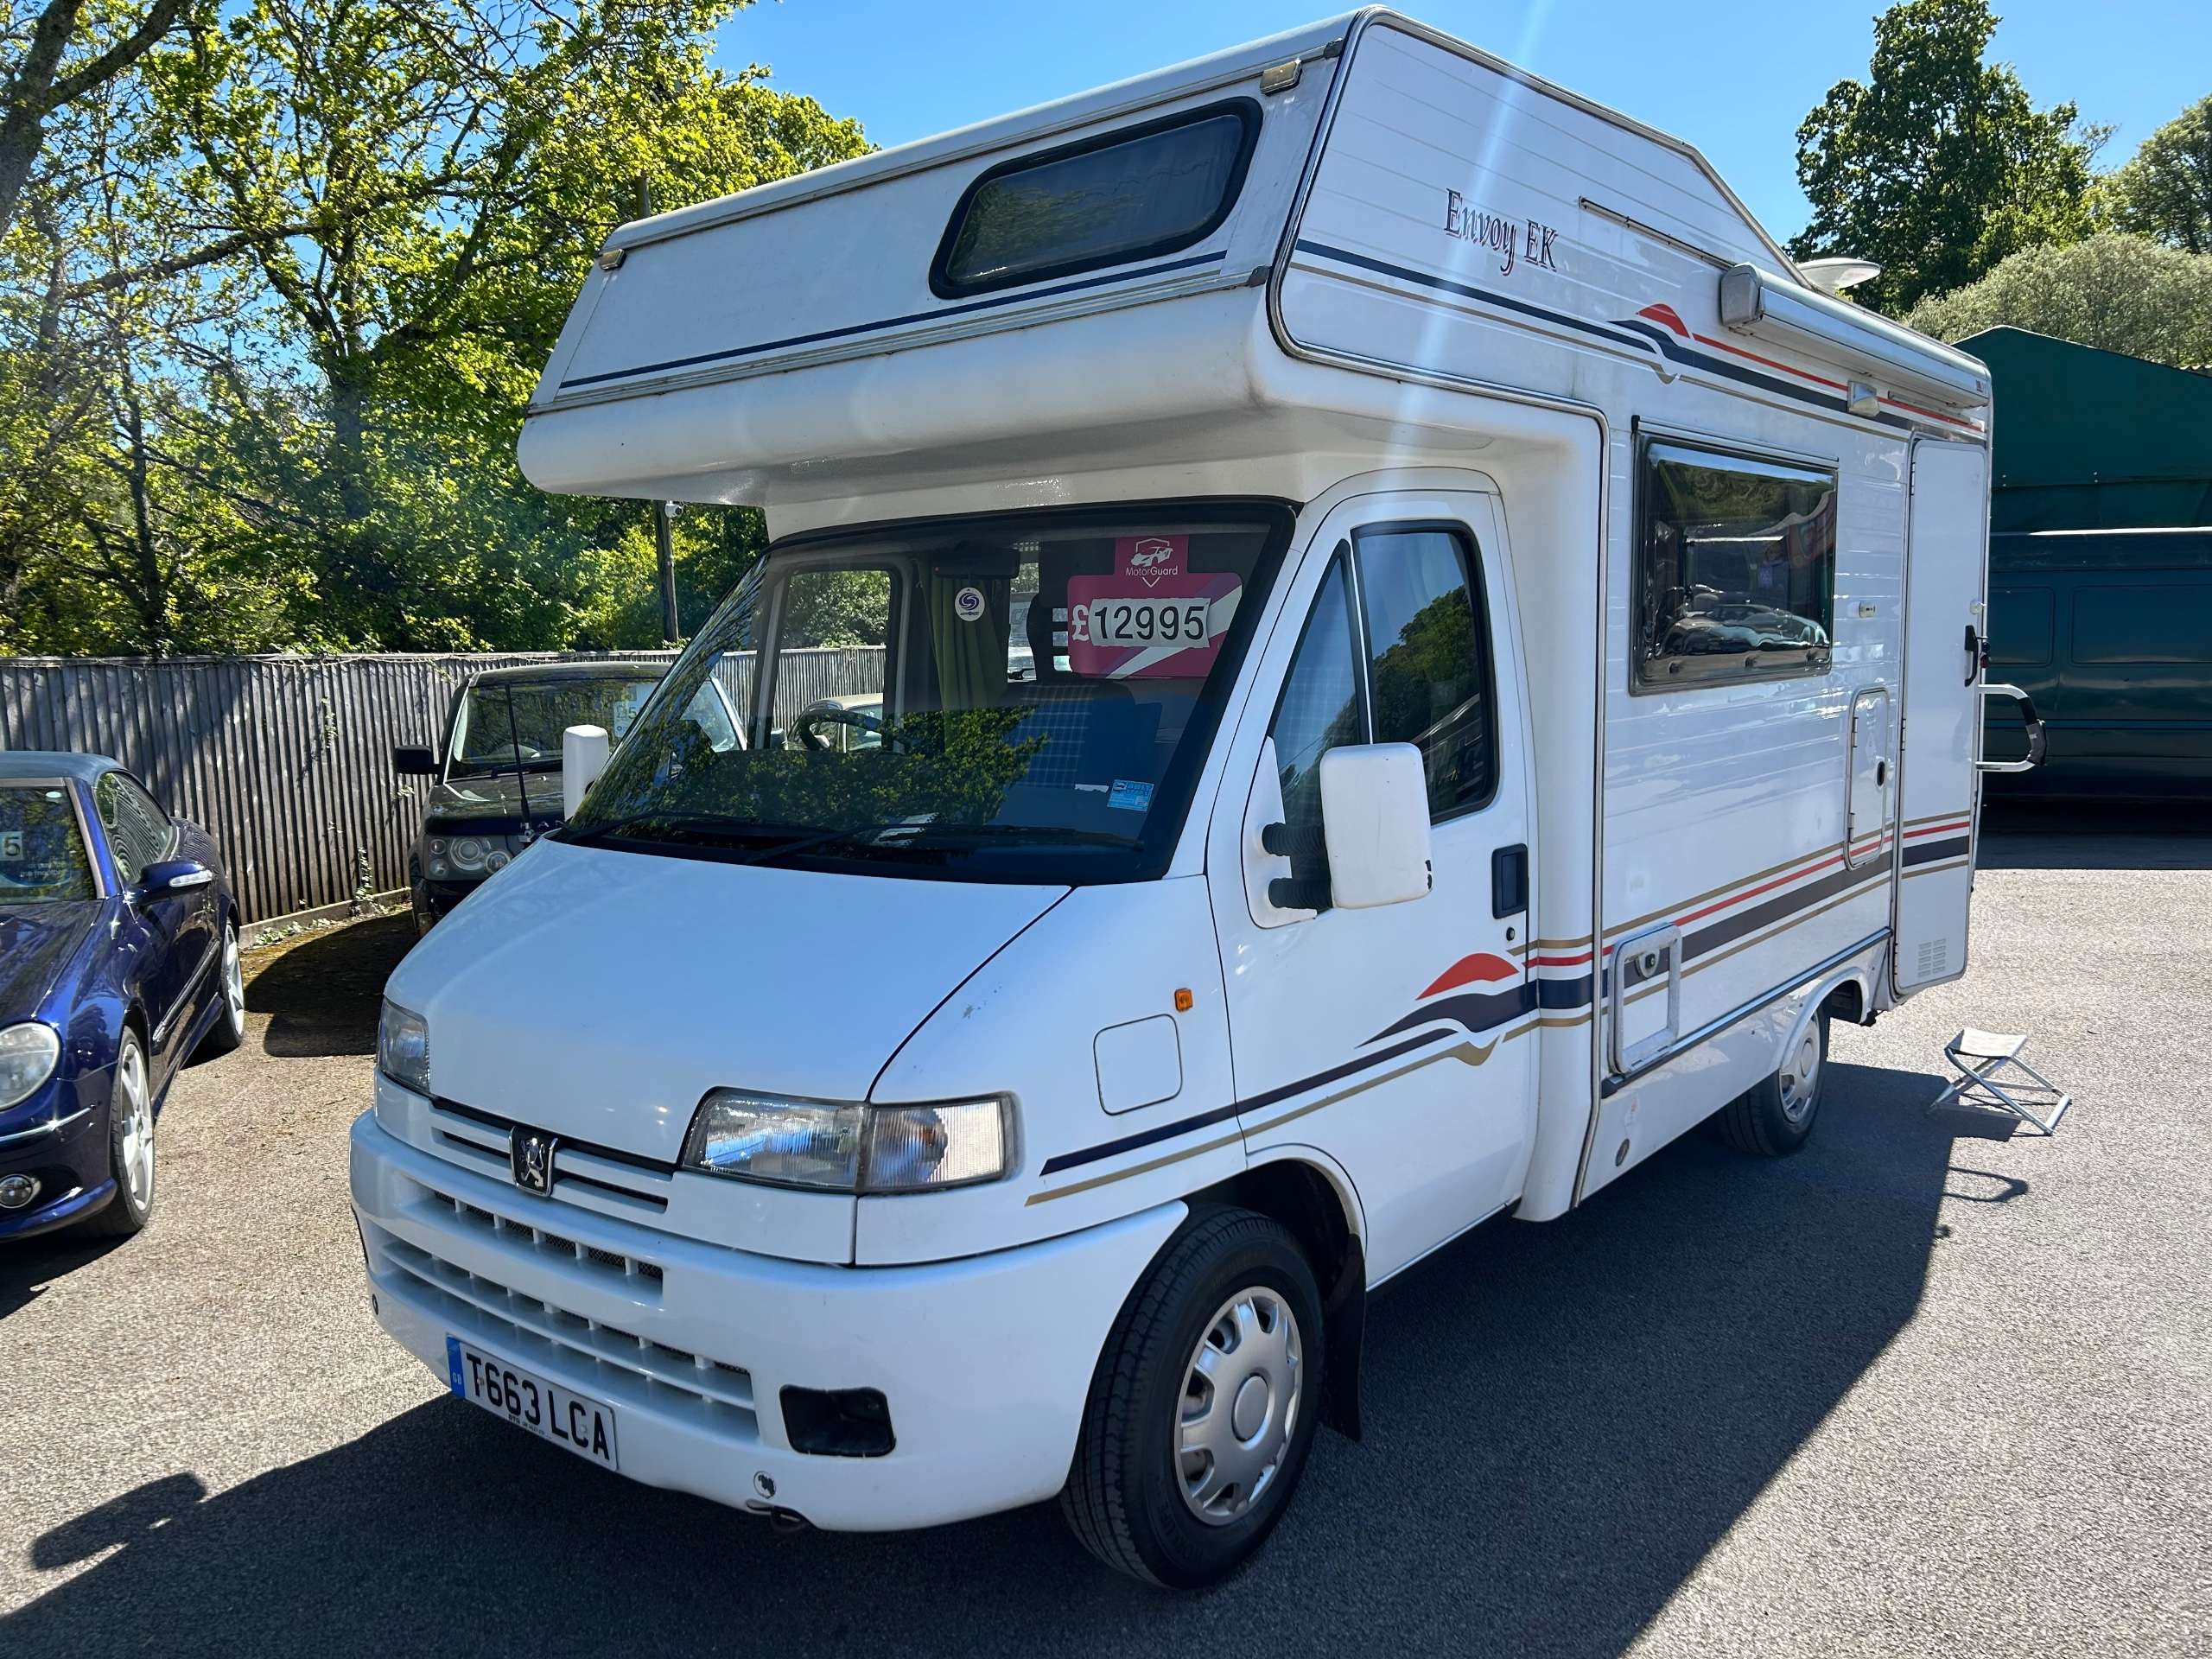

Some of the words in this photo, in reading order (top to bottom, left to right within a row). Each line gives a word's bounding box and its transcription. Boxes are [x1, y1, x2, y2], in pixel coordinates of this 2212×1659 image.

[1444, 188, 1516, 276] Envoy
[1524, 219, 1559, 272] EK
[1126, 565, 1179, 576] MotorGuard
[1071, 604, 1205, 642] £12995
[466, 1352, 541, 1426] T663
[547, 1389, 610, 1460] LCA
